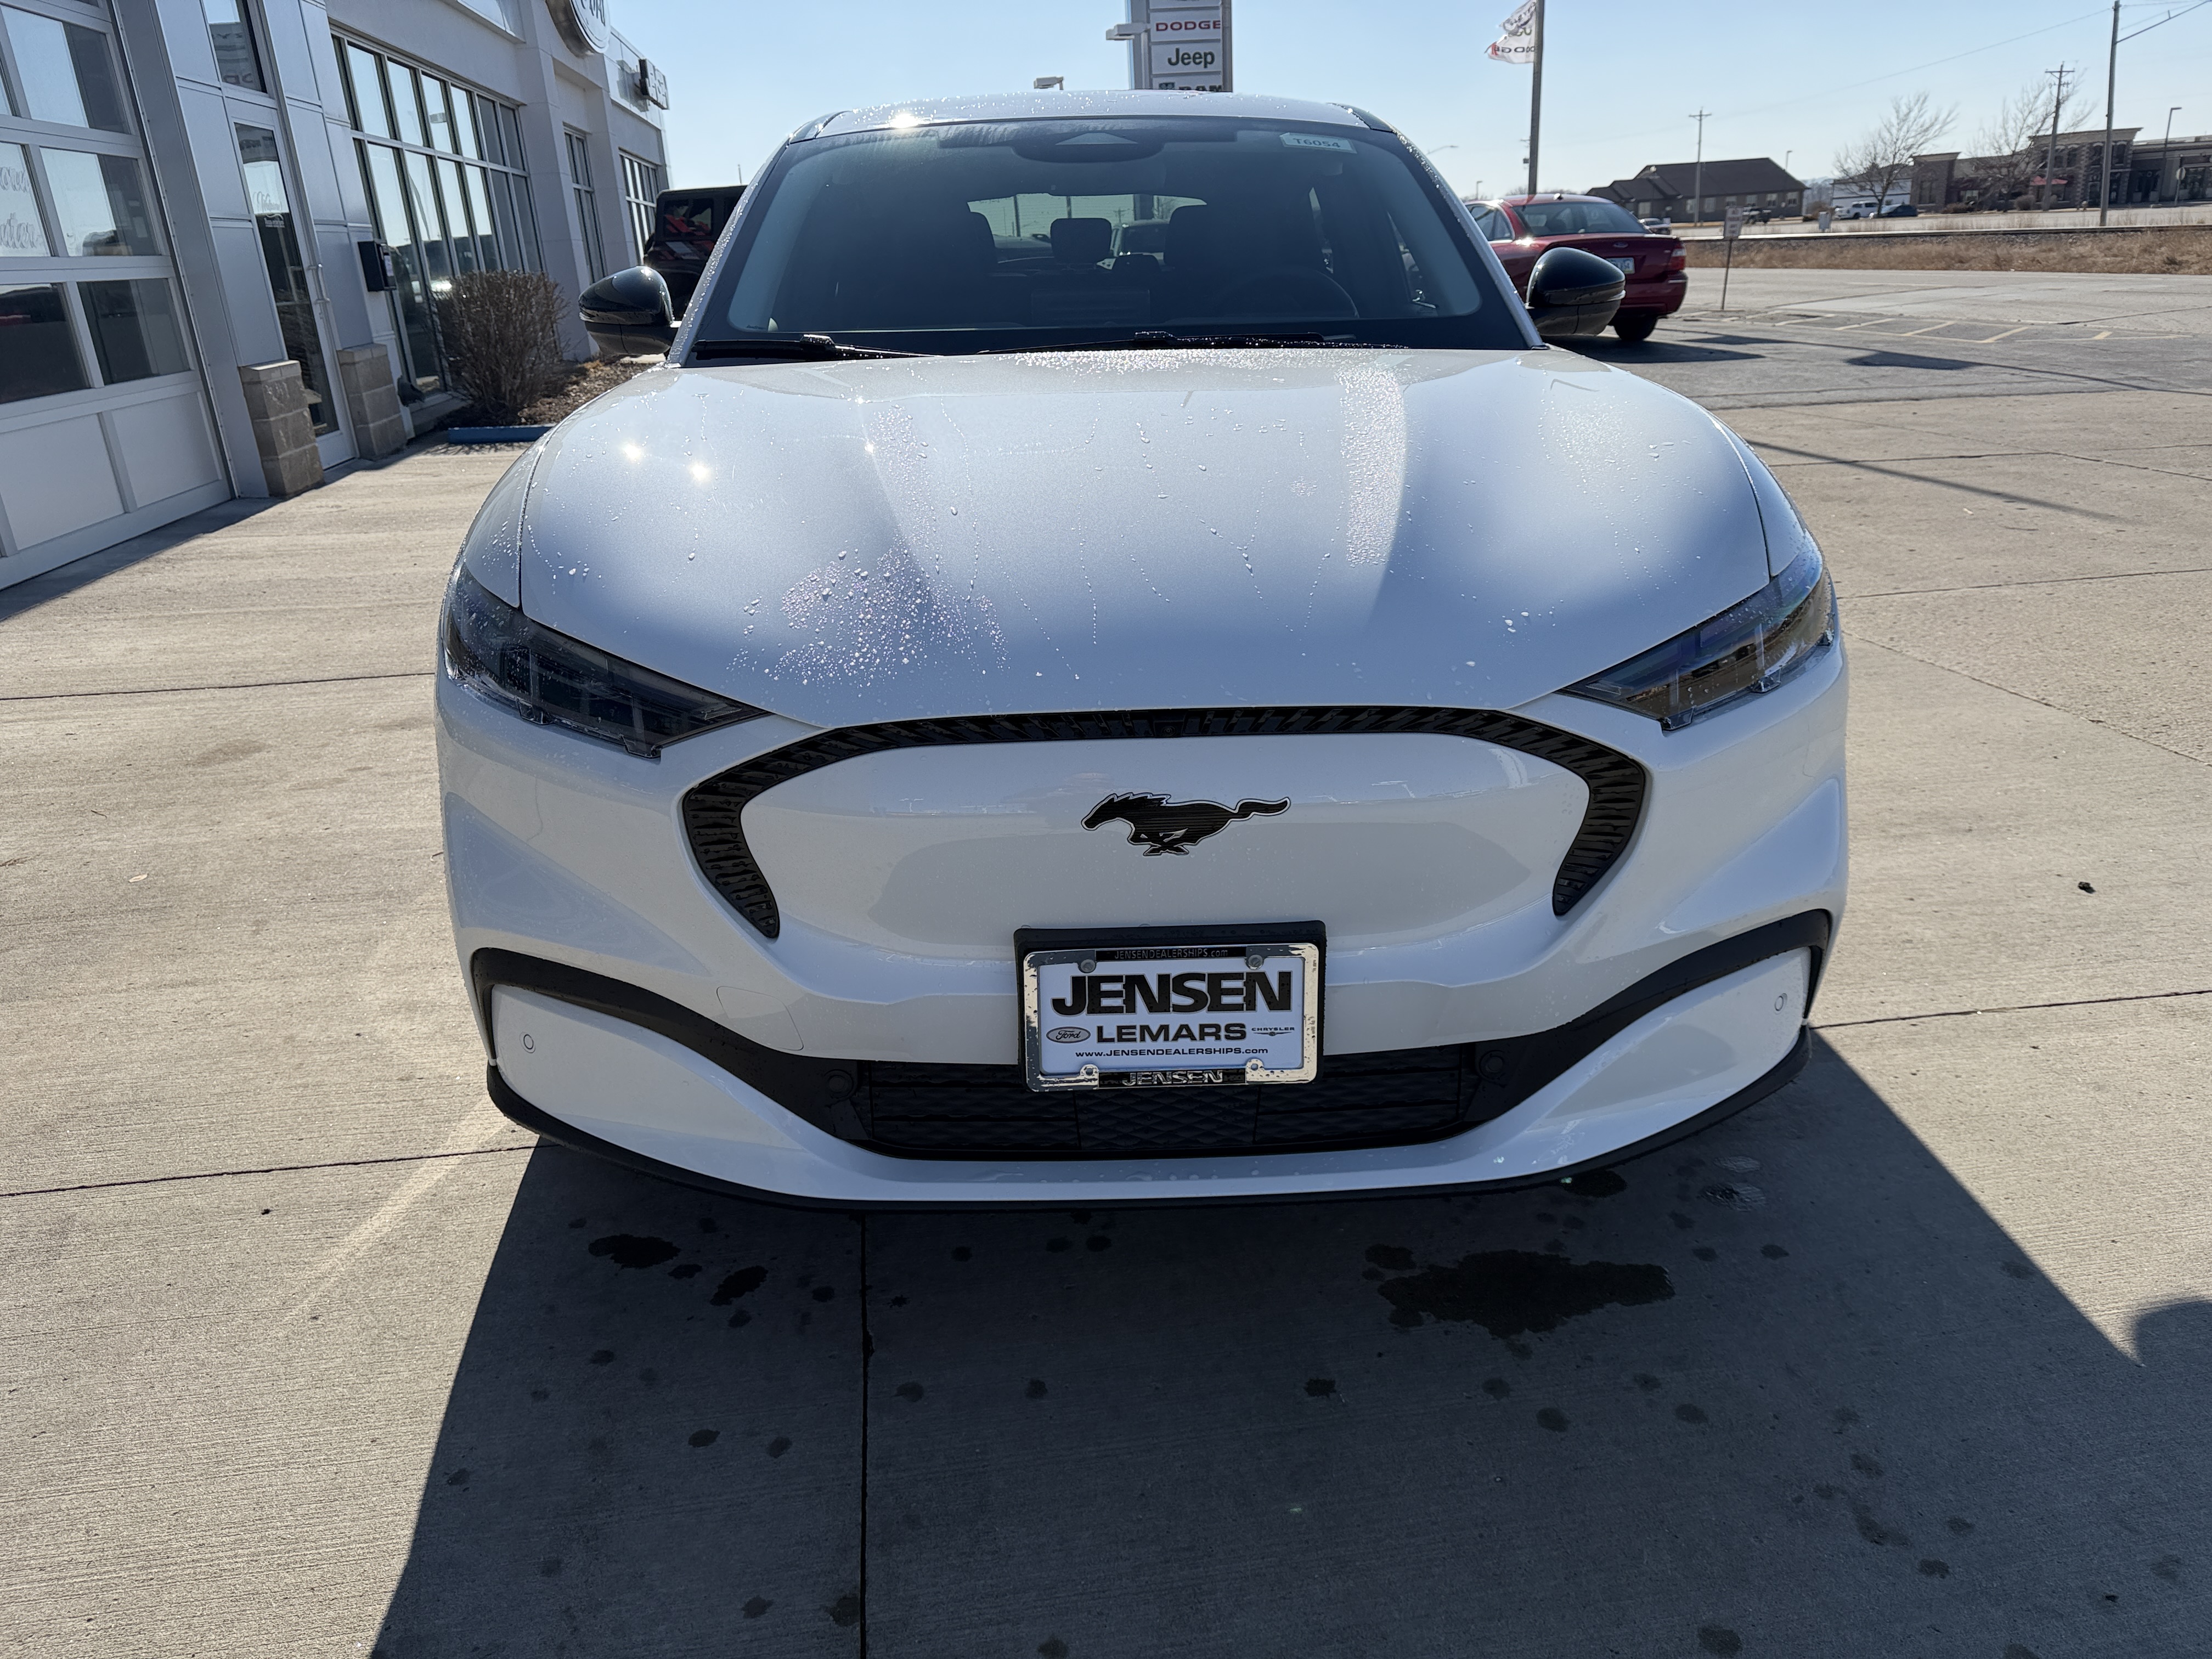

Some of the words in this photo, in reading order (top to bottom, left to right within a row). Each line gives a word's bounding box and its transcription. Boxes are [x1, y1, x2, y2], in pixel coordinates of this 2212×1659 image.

[1156, 20, 1221, 31] DODGE
[1167, 47, 1215, 68] Jeep
[1293, 137, 1341, 148] T6054
[1114, 947, 1228, 960] JENSENDEALERSHIPS.com
[1051, 970, 1293, 1016] JENSEN
[1056, 1029, 1081, 1041] Ford
[1097, 1023, 1247, 1043] LEMARS
[1075, 1047, 1268, 1057] www.JENSENDEALERSHIPS.com
[1122, 1070, 1223, 1086] JENSEN
